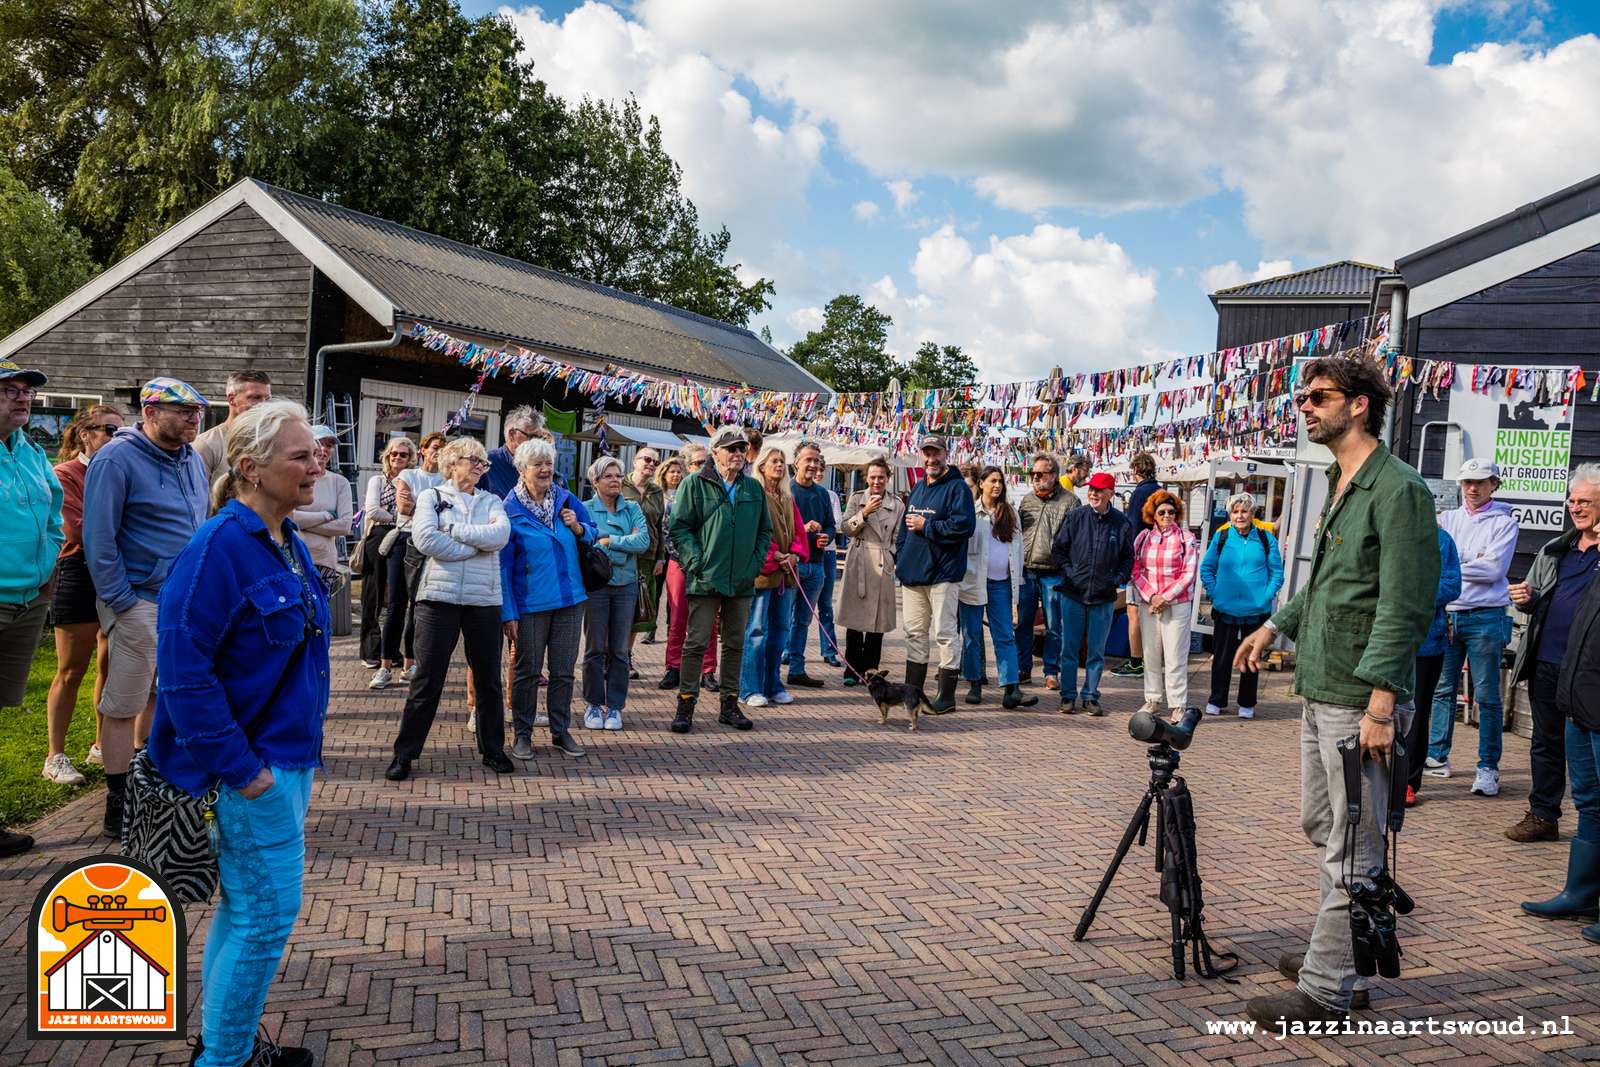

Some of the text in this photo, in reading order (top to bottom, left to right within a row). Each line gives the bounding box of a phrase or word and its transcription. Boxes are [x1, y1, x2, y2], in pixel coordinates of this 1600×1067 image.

[1496, 430, 1570, 449] RUNDVEE
[1495, 448, 1569, 467] MUSEUM
[1517, 467, 1567, 480] GROOTES
[1500, 479, 1566, 493] ARTSWOUD
[1510, 508, 1563, 526] GANG
